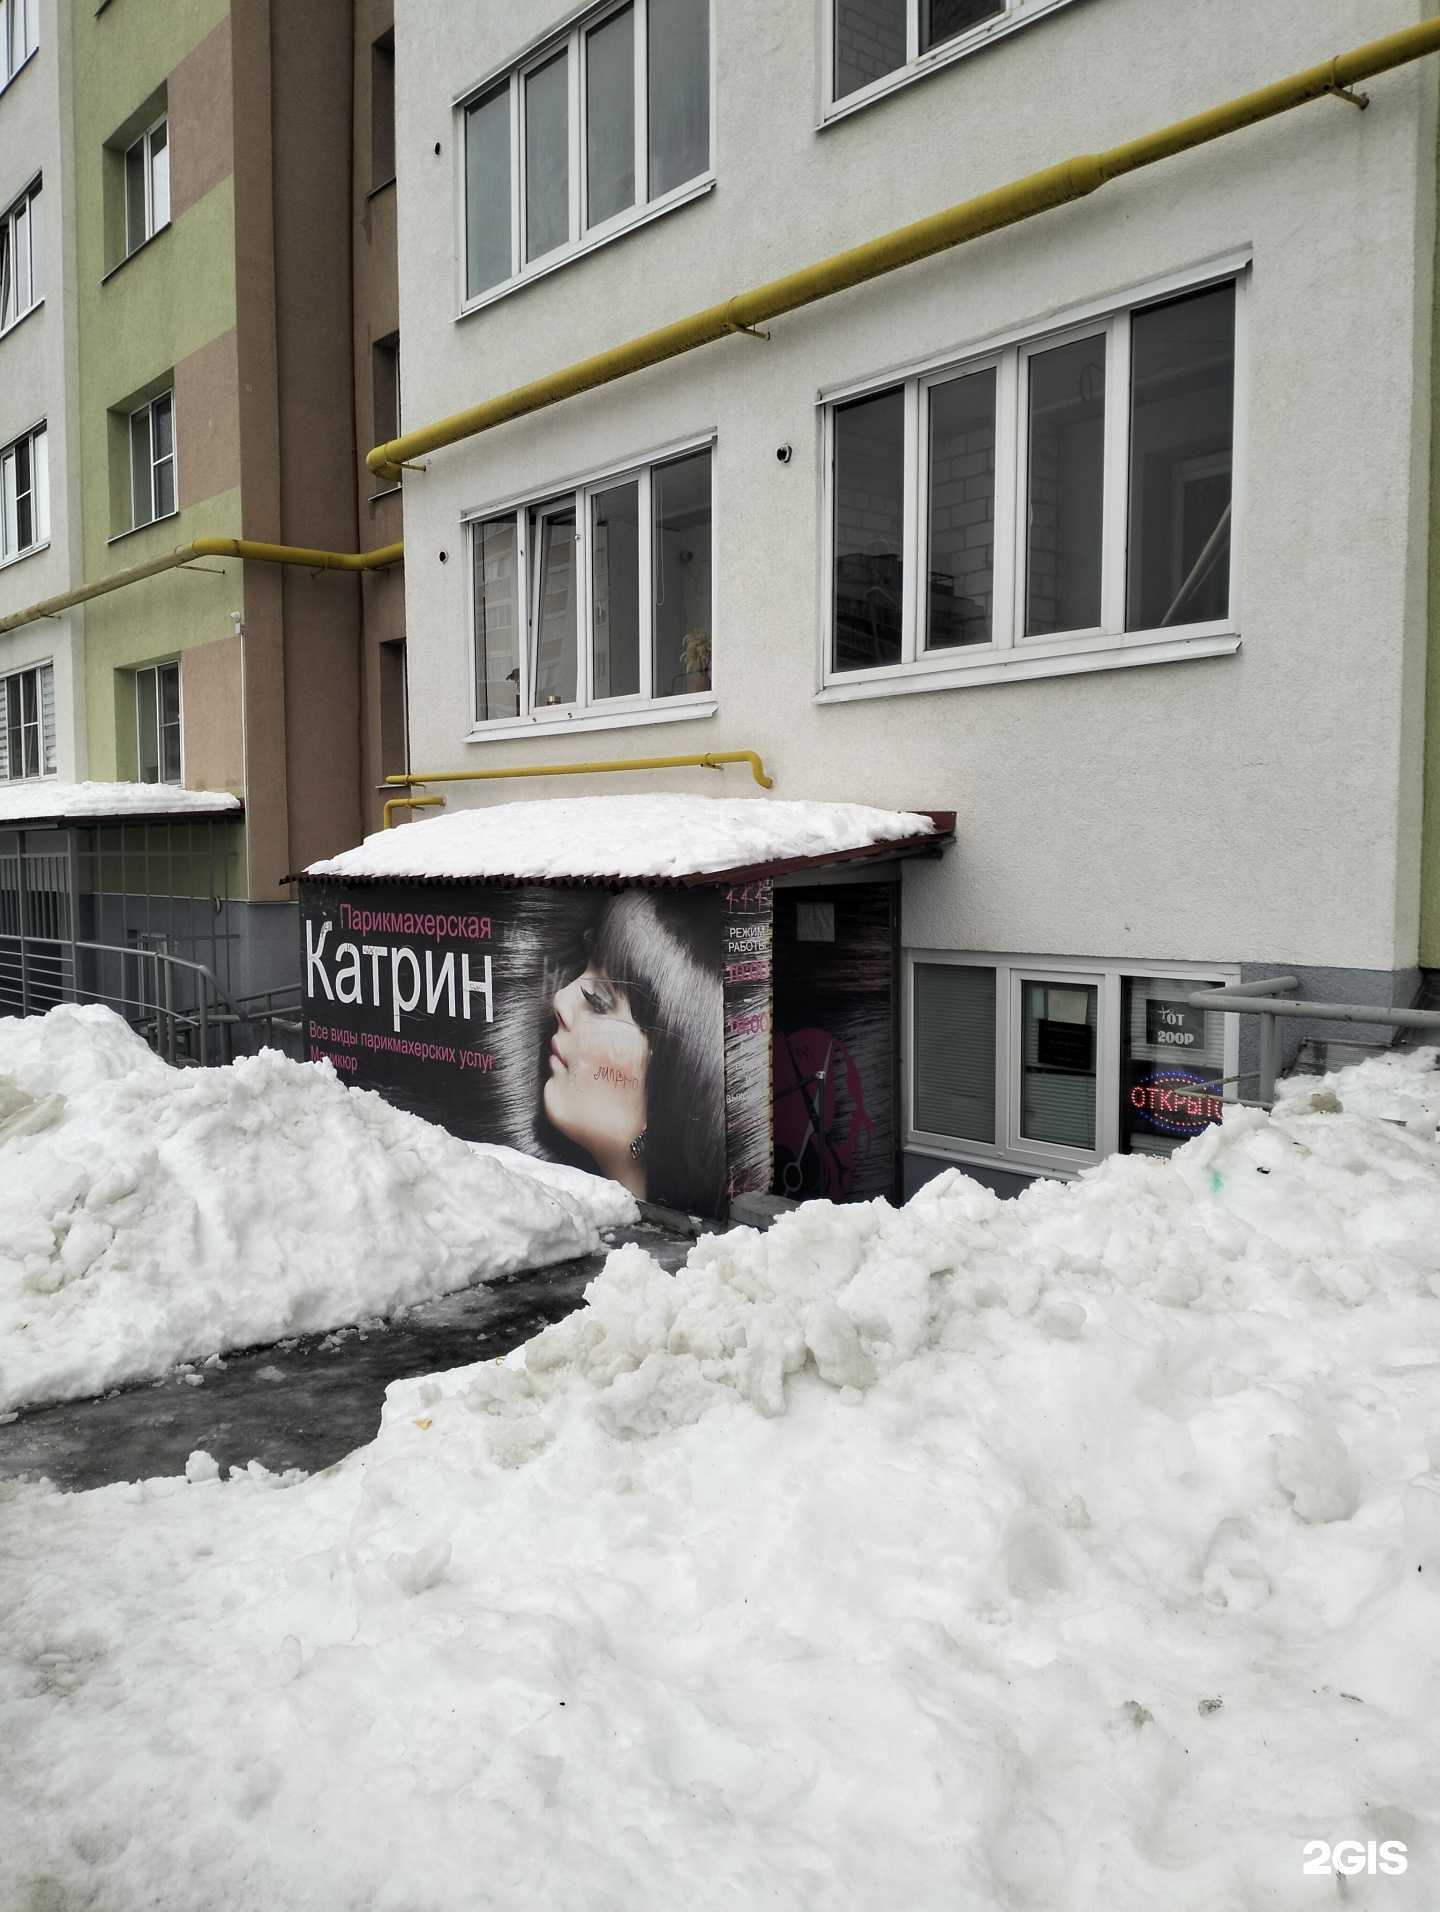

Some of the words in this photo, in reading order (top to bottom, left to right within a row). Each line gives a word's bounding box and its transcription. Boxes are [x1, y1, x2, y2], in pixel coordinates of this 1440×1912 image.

[340, 903, 492, 942] Парикмахерская
[729, 926, 767, 938] РЕЖИМ
[728, 940, 769, 952] РАБОТЫ
[305, 919, 494, 1032] Катрин
[1166, 1013, 1185, 1026] ОТ
[309, 1020, 329, 1040] Все
[331, 1027, 358, 1046] виды
[361, 1032, 456, 1063] парикмахерских
[459, 1048, 497, 1074] услуг
